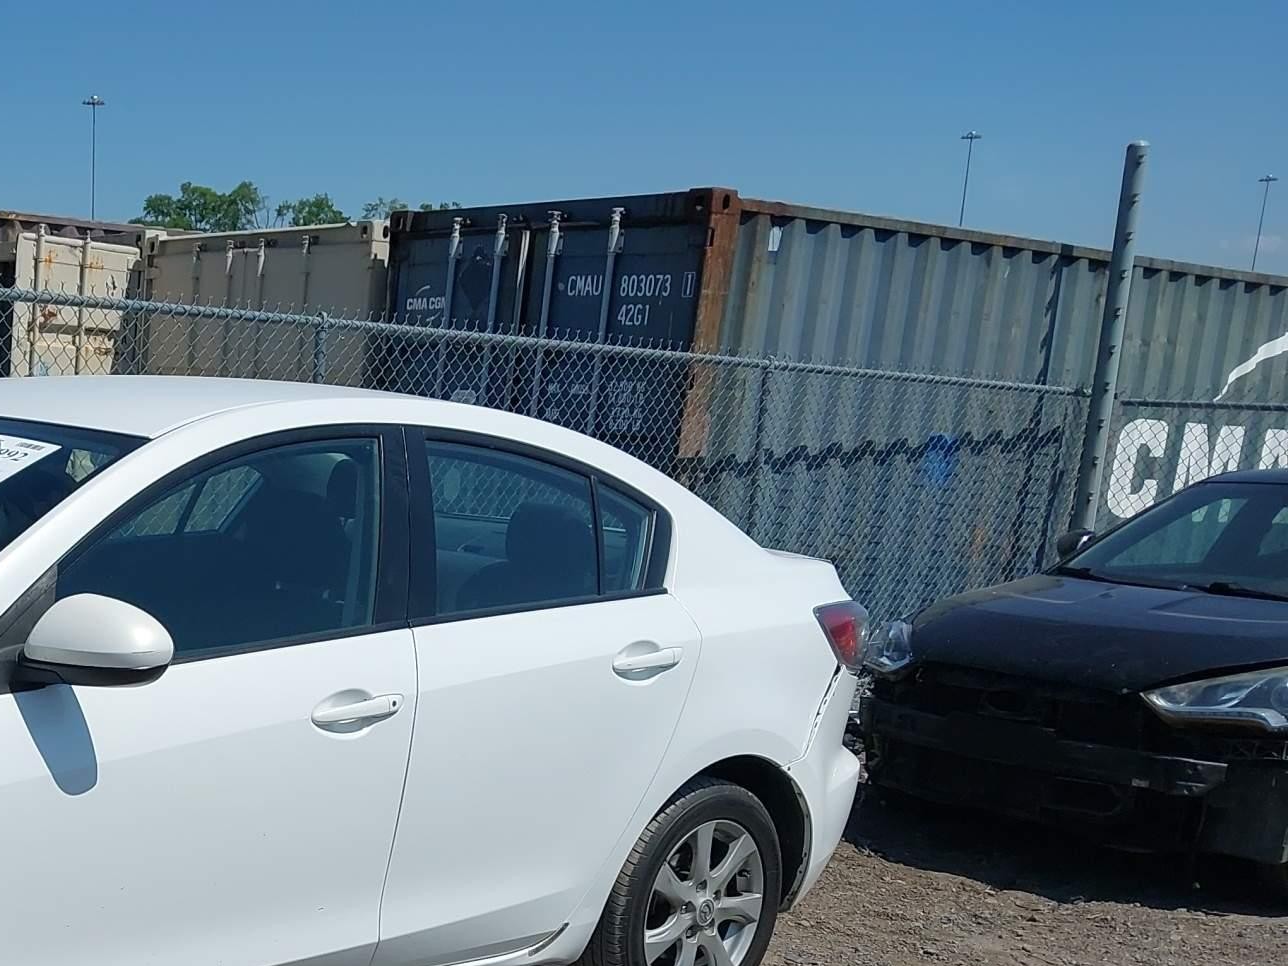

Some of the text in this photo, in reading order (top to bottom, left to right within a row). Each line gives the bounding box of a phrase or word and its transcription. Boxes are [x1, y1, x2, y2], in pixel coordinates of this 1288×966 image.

[567, 274, 602, 297] CMAU
[620, 274, 671, 297] 803073
[406, 297, 427, 311] CMA
[617, 304, 649, 326] 42G1
